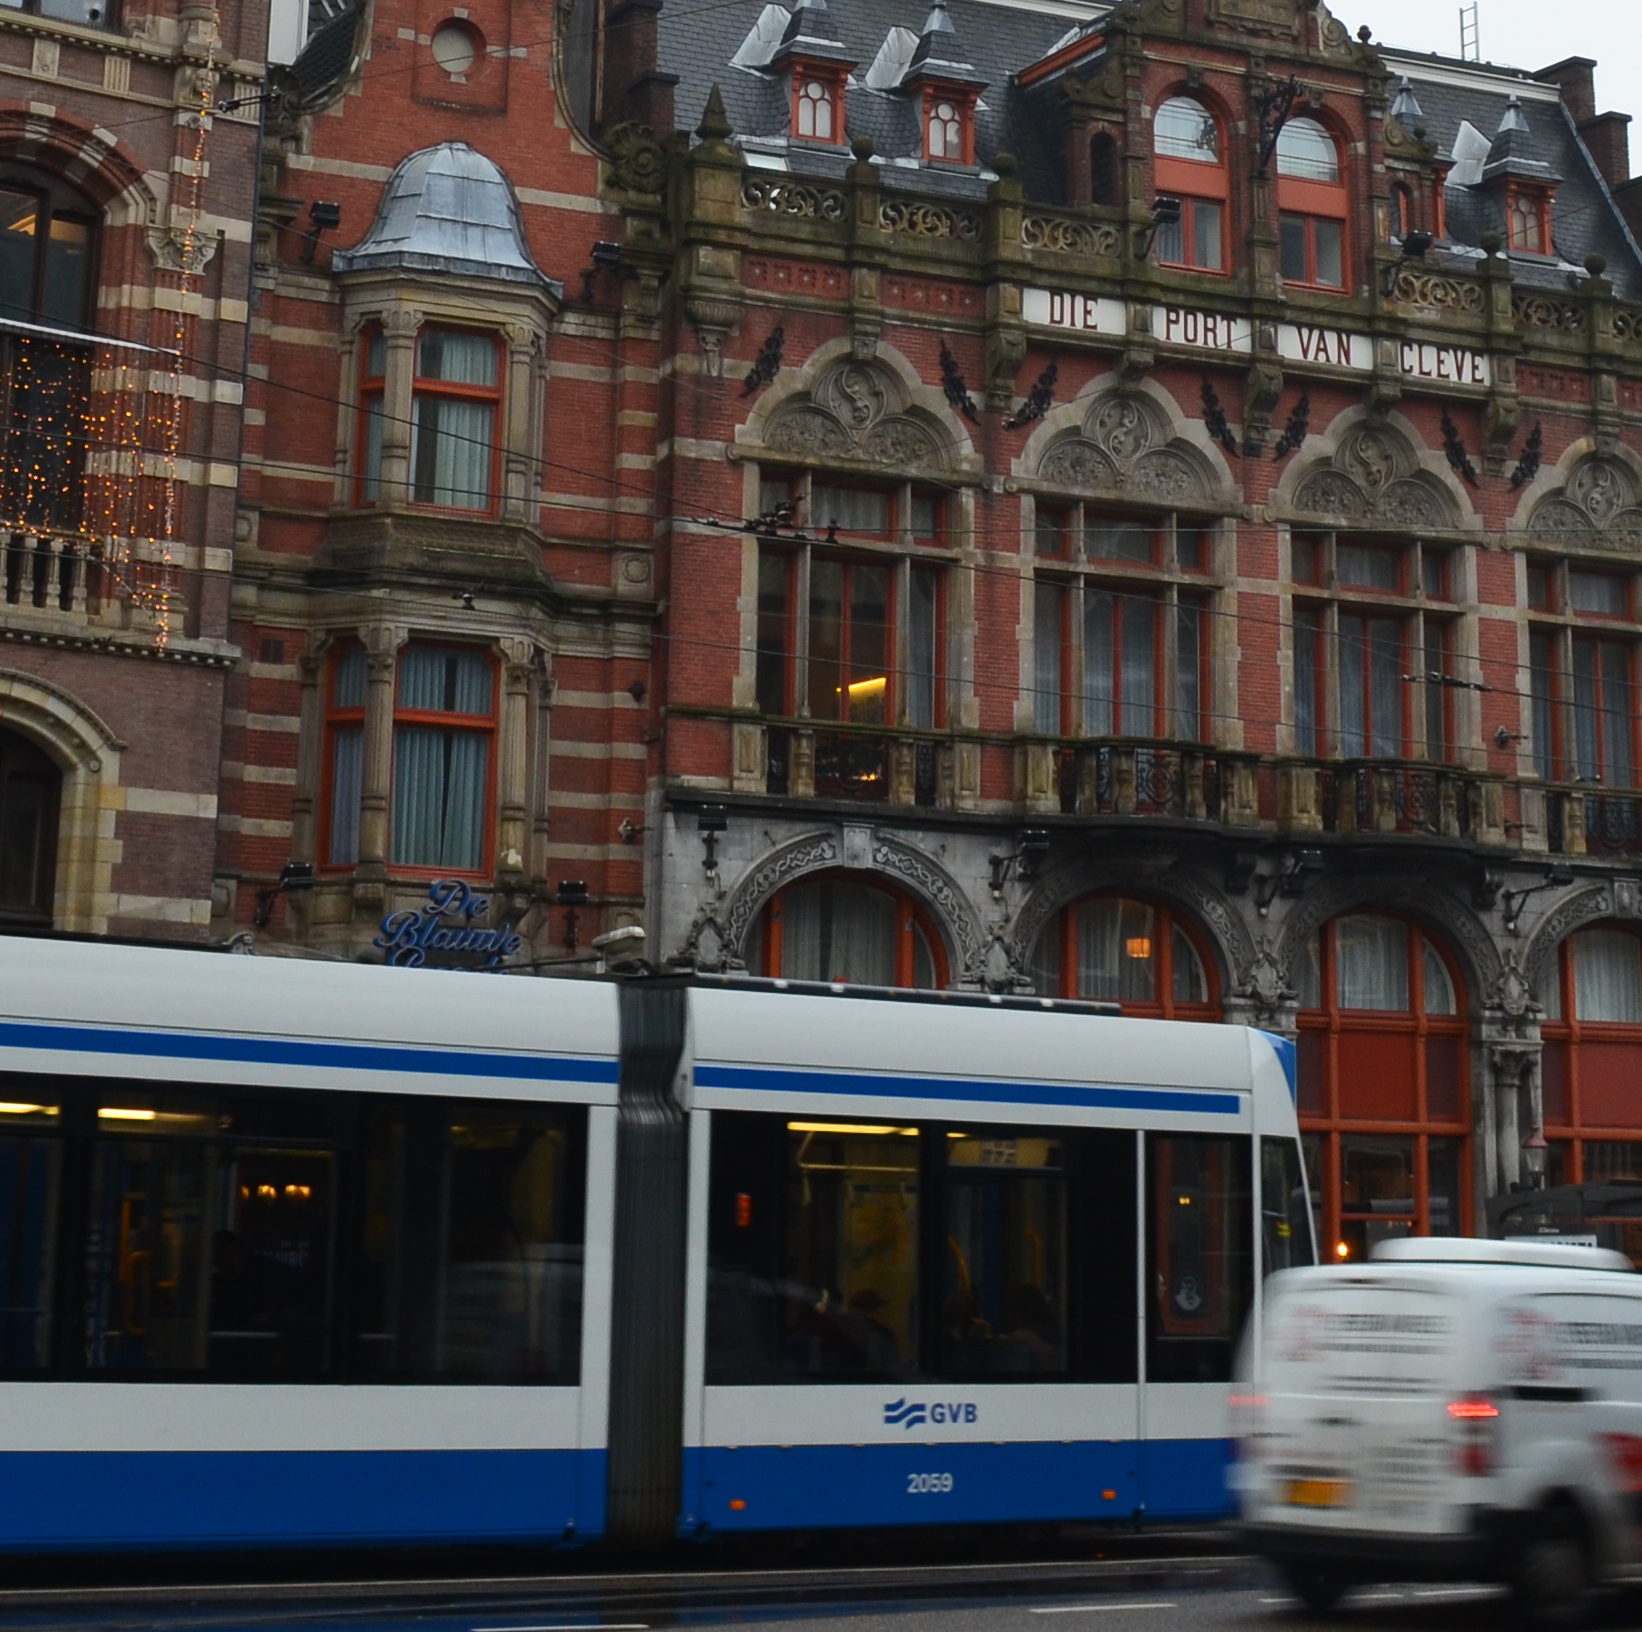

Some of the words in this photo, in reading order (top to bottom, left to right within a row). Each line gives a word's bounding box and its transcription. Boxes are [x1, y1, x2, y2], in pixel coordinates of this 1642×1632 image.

[1049, 292, 1099, 330] DIE
[1164, 308, 1238, 350] PORT
[1298, 326, 1353, 366] VAN
[1400, 343, 1487, 385] CLEVE
[423, 878, 489, 918] De
[373, 911, 523, 955] Blauwe
[931, 1403, 978, 1423] GVB
[906, 1473, 954, 1493] 2059
